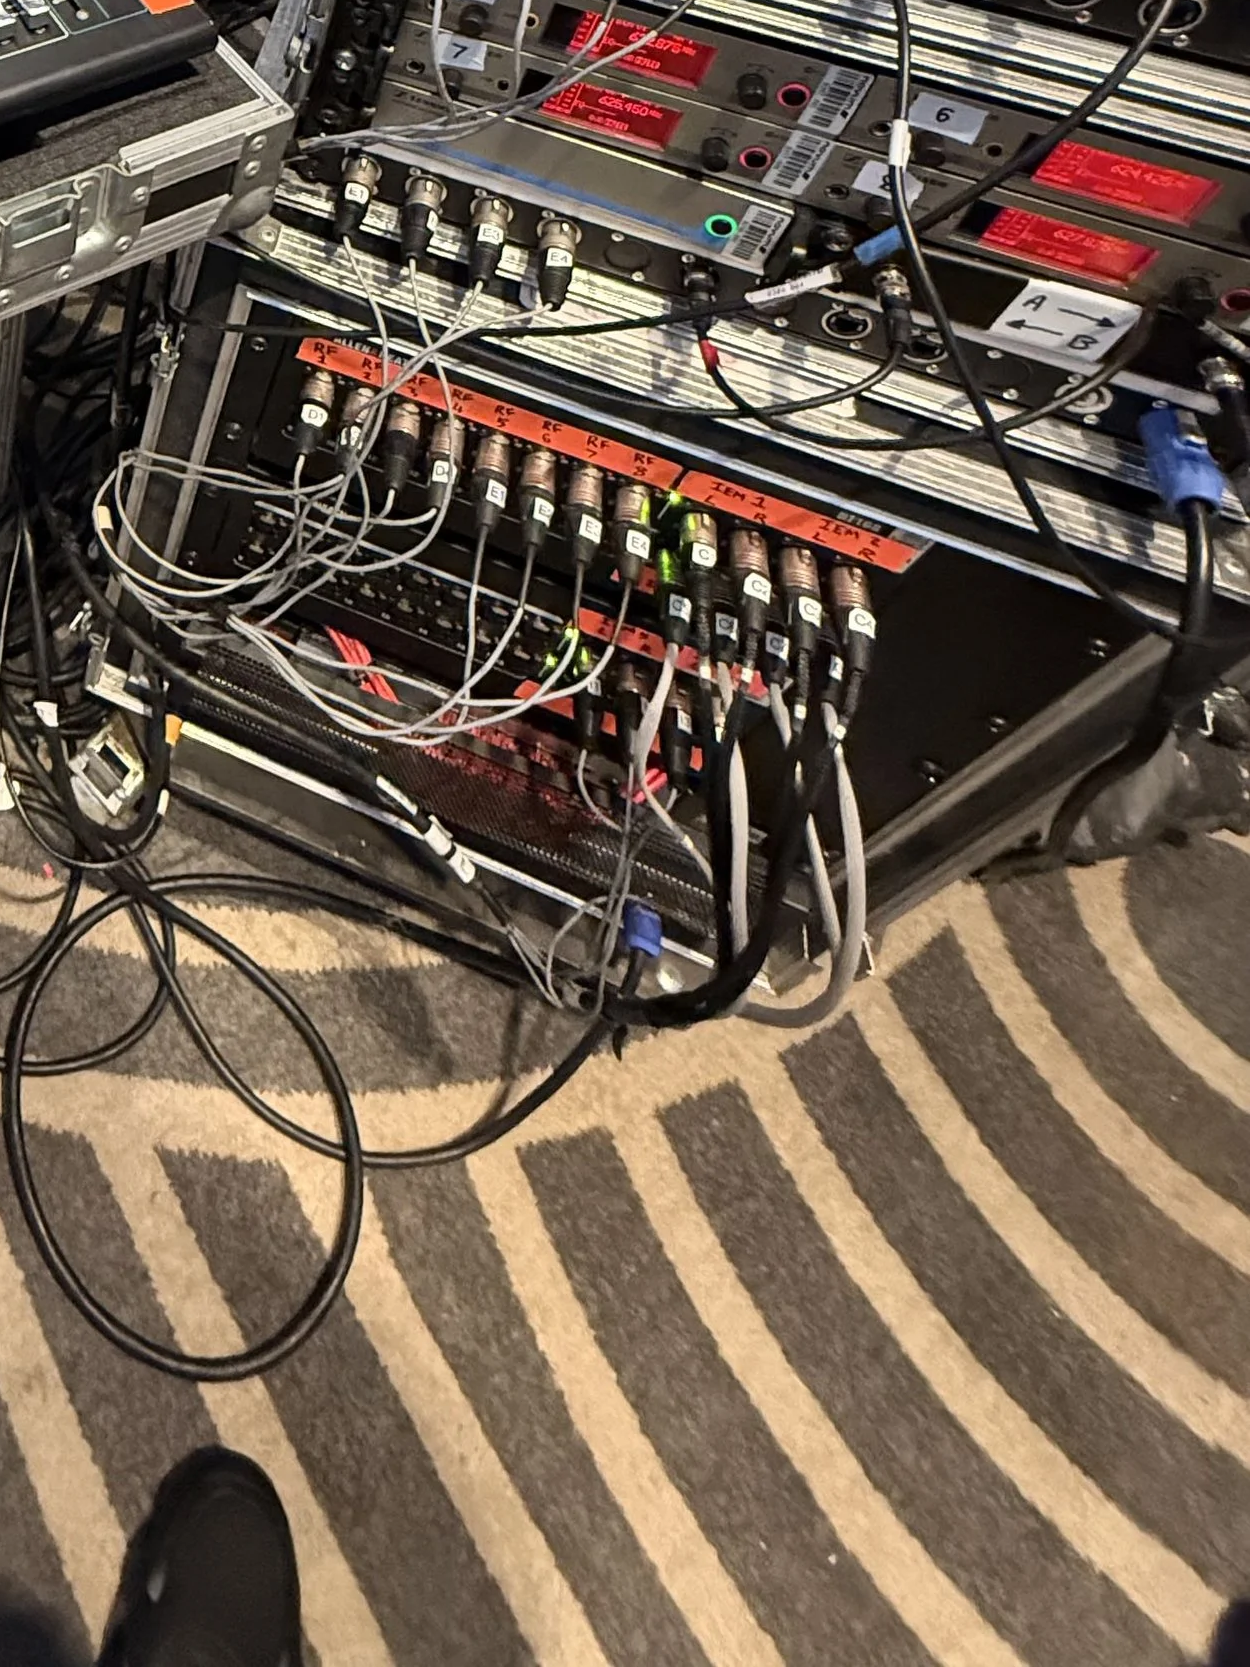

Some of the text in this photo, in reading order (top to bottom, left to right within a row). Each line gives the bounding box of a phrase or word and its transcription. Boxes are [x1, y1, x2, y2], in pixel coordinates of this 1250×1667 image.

[452, 43, 468, 59] 7
[598, 95, 650, 117] 625.450
[935, 107, 955, 123] 6
[348, 186, 364, 200] E1
[1022, 294, 1048, 312] A
[1068, 334, 1098, 351] B
[308, 409, 324, 420] D1
[491, 487, 506, 501] E1
[711, 482, 767, 508] IEM 1
[704, 494, 767, 524] L R
[818, 518, 859, 540] IEM
[631, 536, 647, 549] E4
[812, 532, 877, 562] L R
